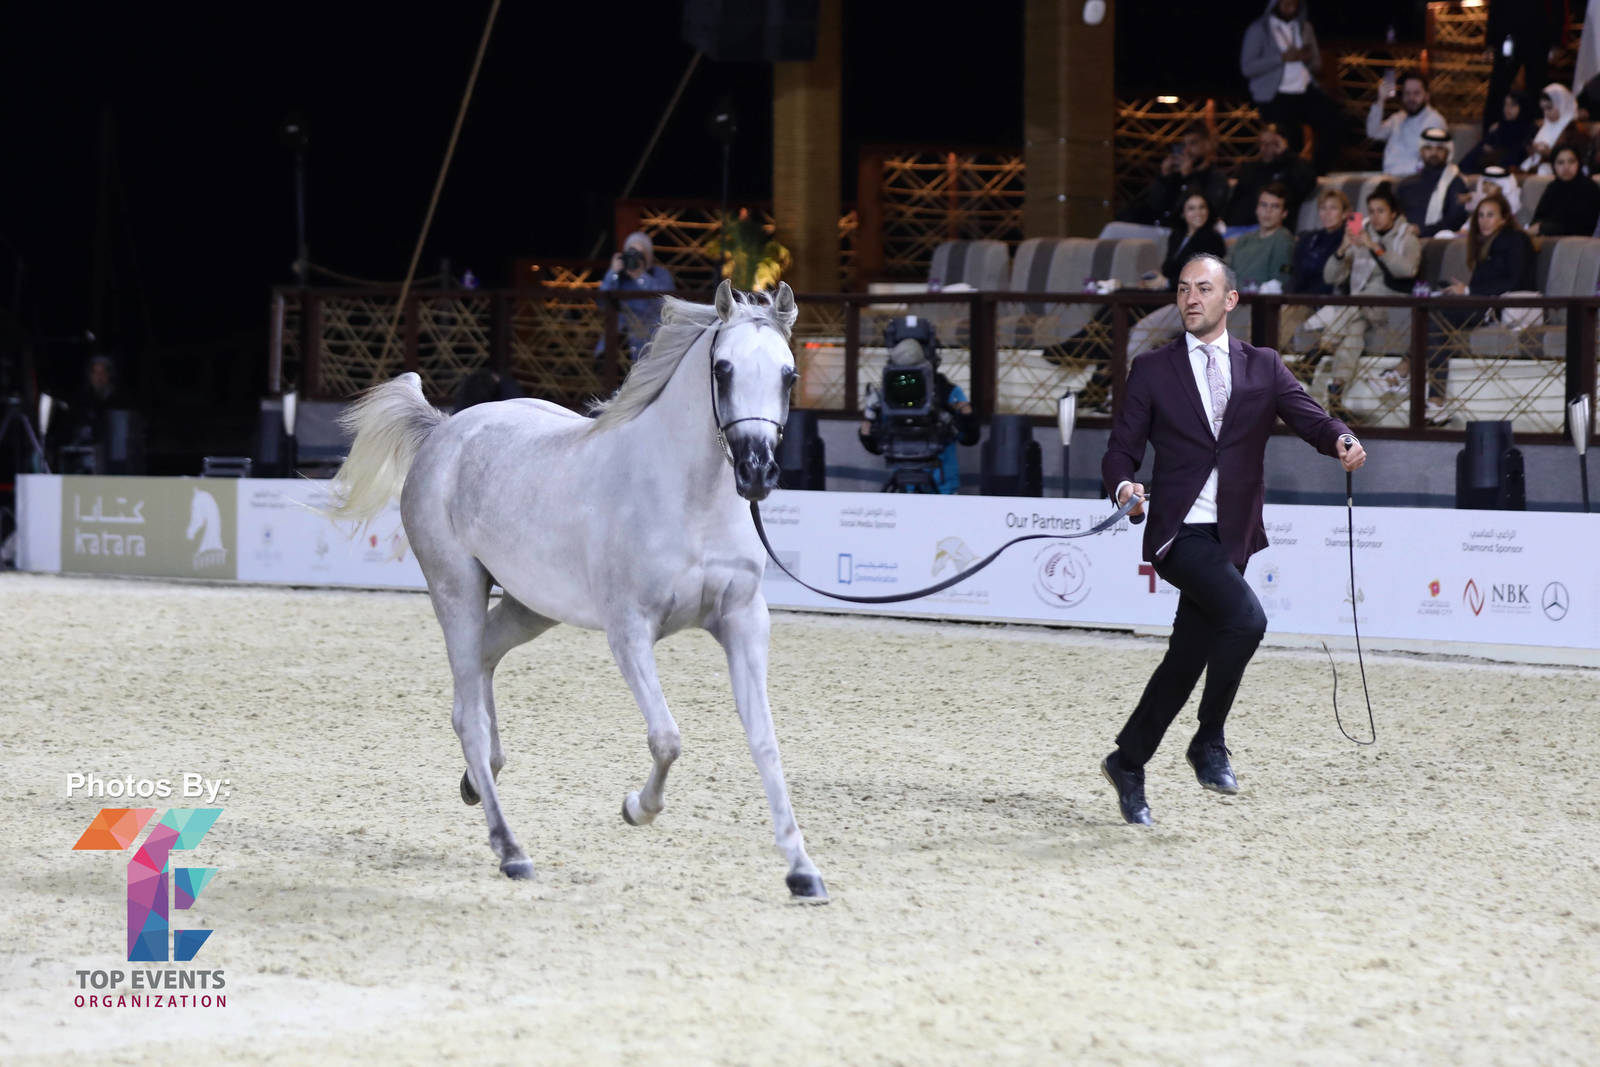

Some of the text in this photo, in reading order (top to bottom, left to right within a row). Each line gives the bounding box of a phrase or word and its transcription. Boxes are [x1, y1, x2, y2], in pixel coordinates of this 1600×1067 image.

[1006, 512, 1081, 530] Our Partners
[75, 528, 146, 556] katara
[1271, 536, 1298, 546] Sponsor
[1356, 538, 1383, 549] Sponsor
[1462, 542, 1523, 553] Diamond Sponsor
[1491, 584, 1530, 603] NBK
